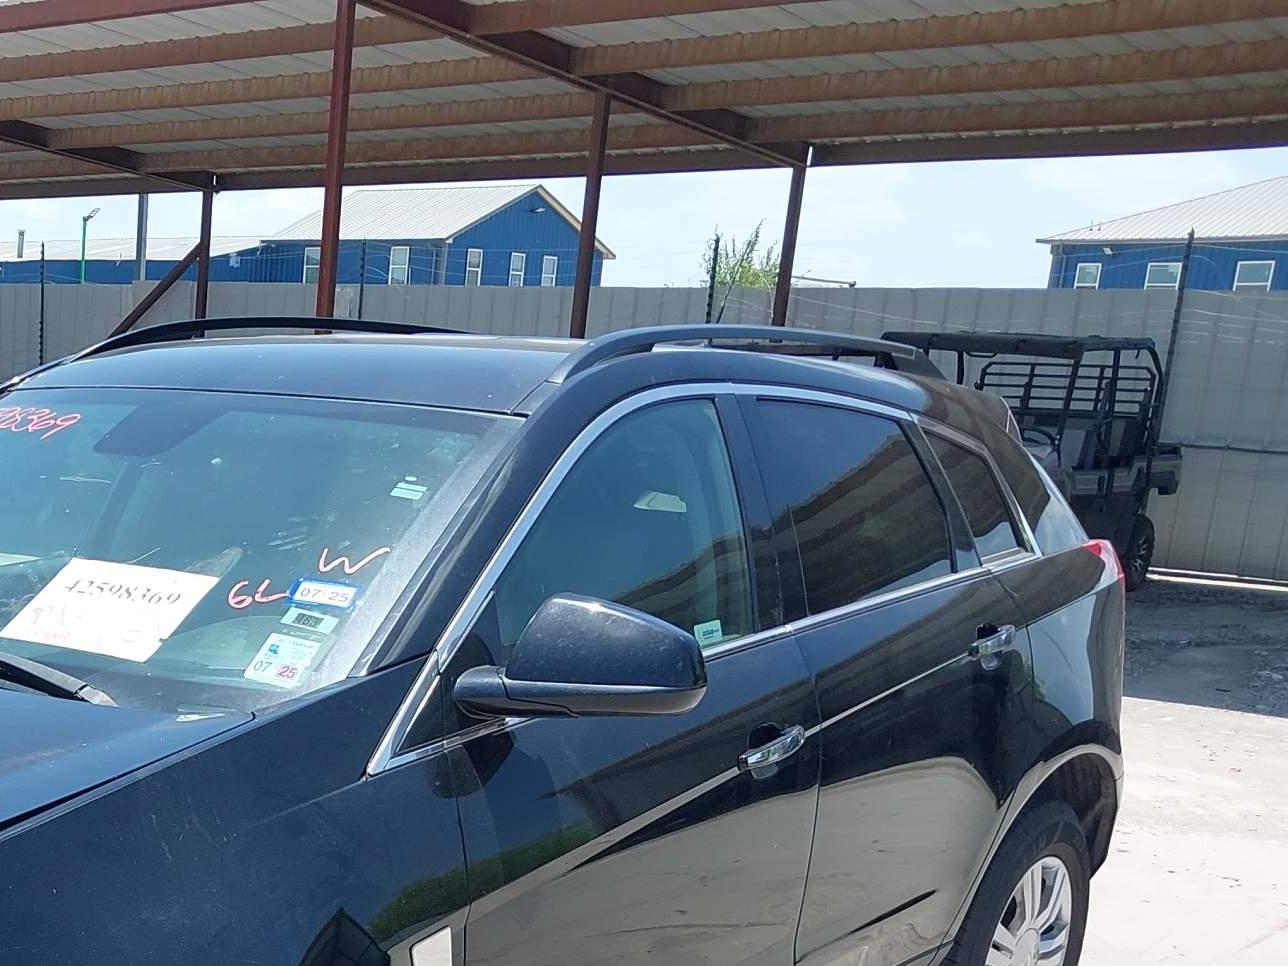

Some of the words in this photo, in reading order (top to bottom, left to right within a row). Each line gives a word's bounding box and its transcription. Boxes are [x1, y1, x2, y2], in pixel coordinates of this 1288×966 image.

[64, 577, 183, 606] 42598369
[300, 586, 322, 599] 07
[327, 590, 350, 604] 25
[253, 660, 273, 673] 07
[279, 665, 299, 680] 25
